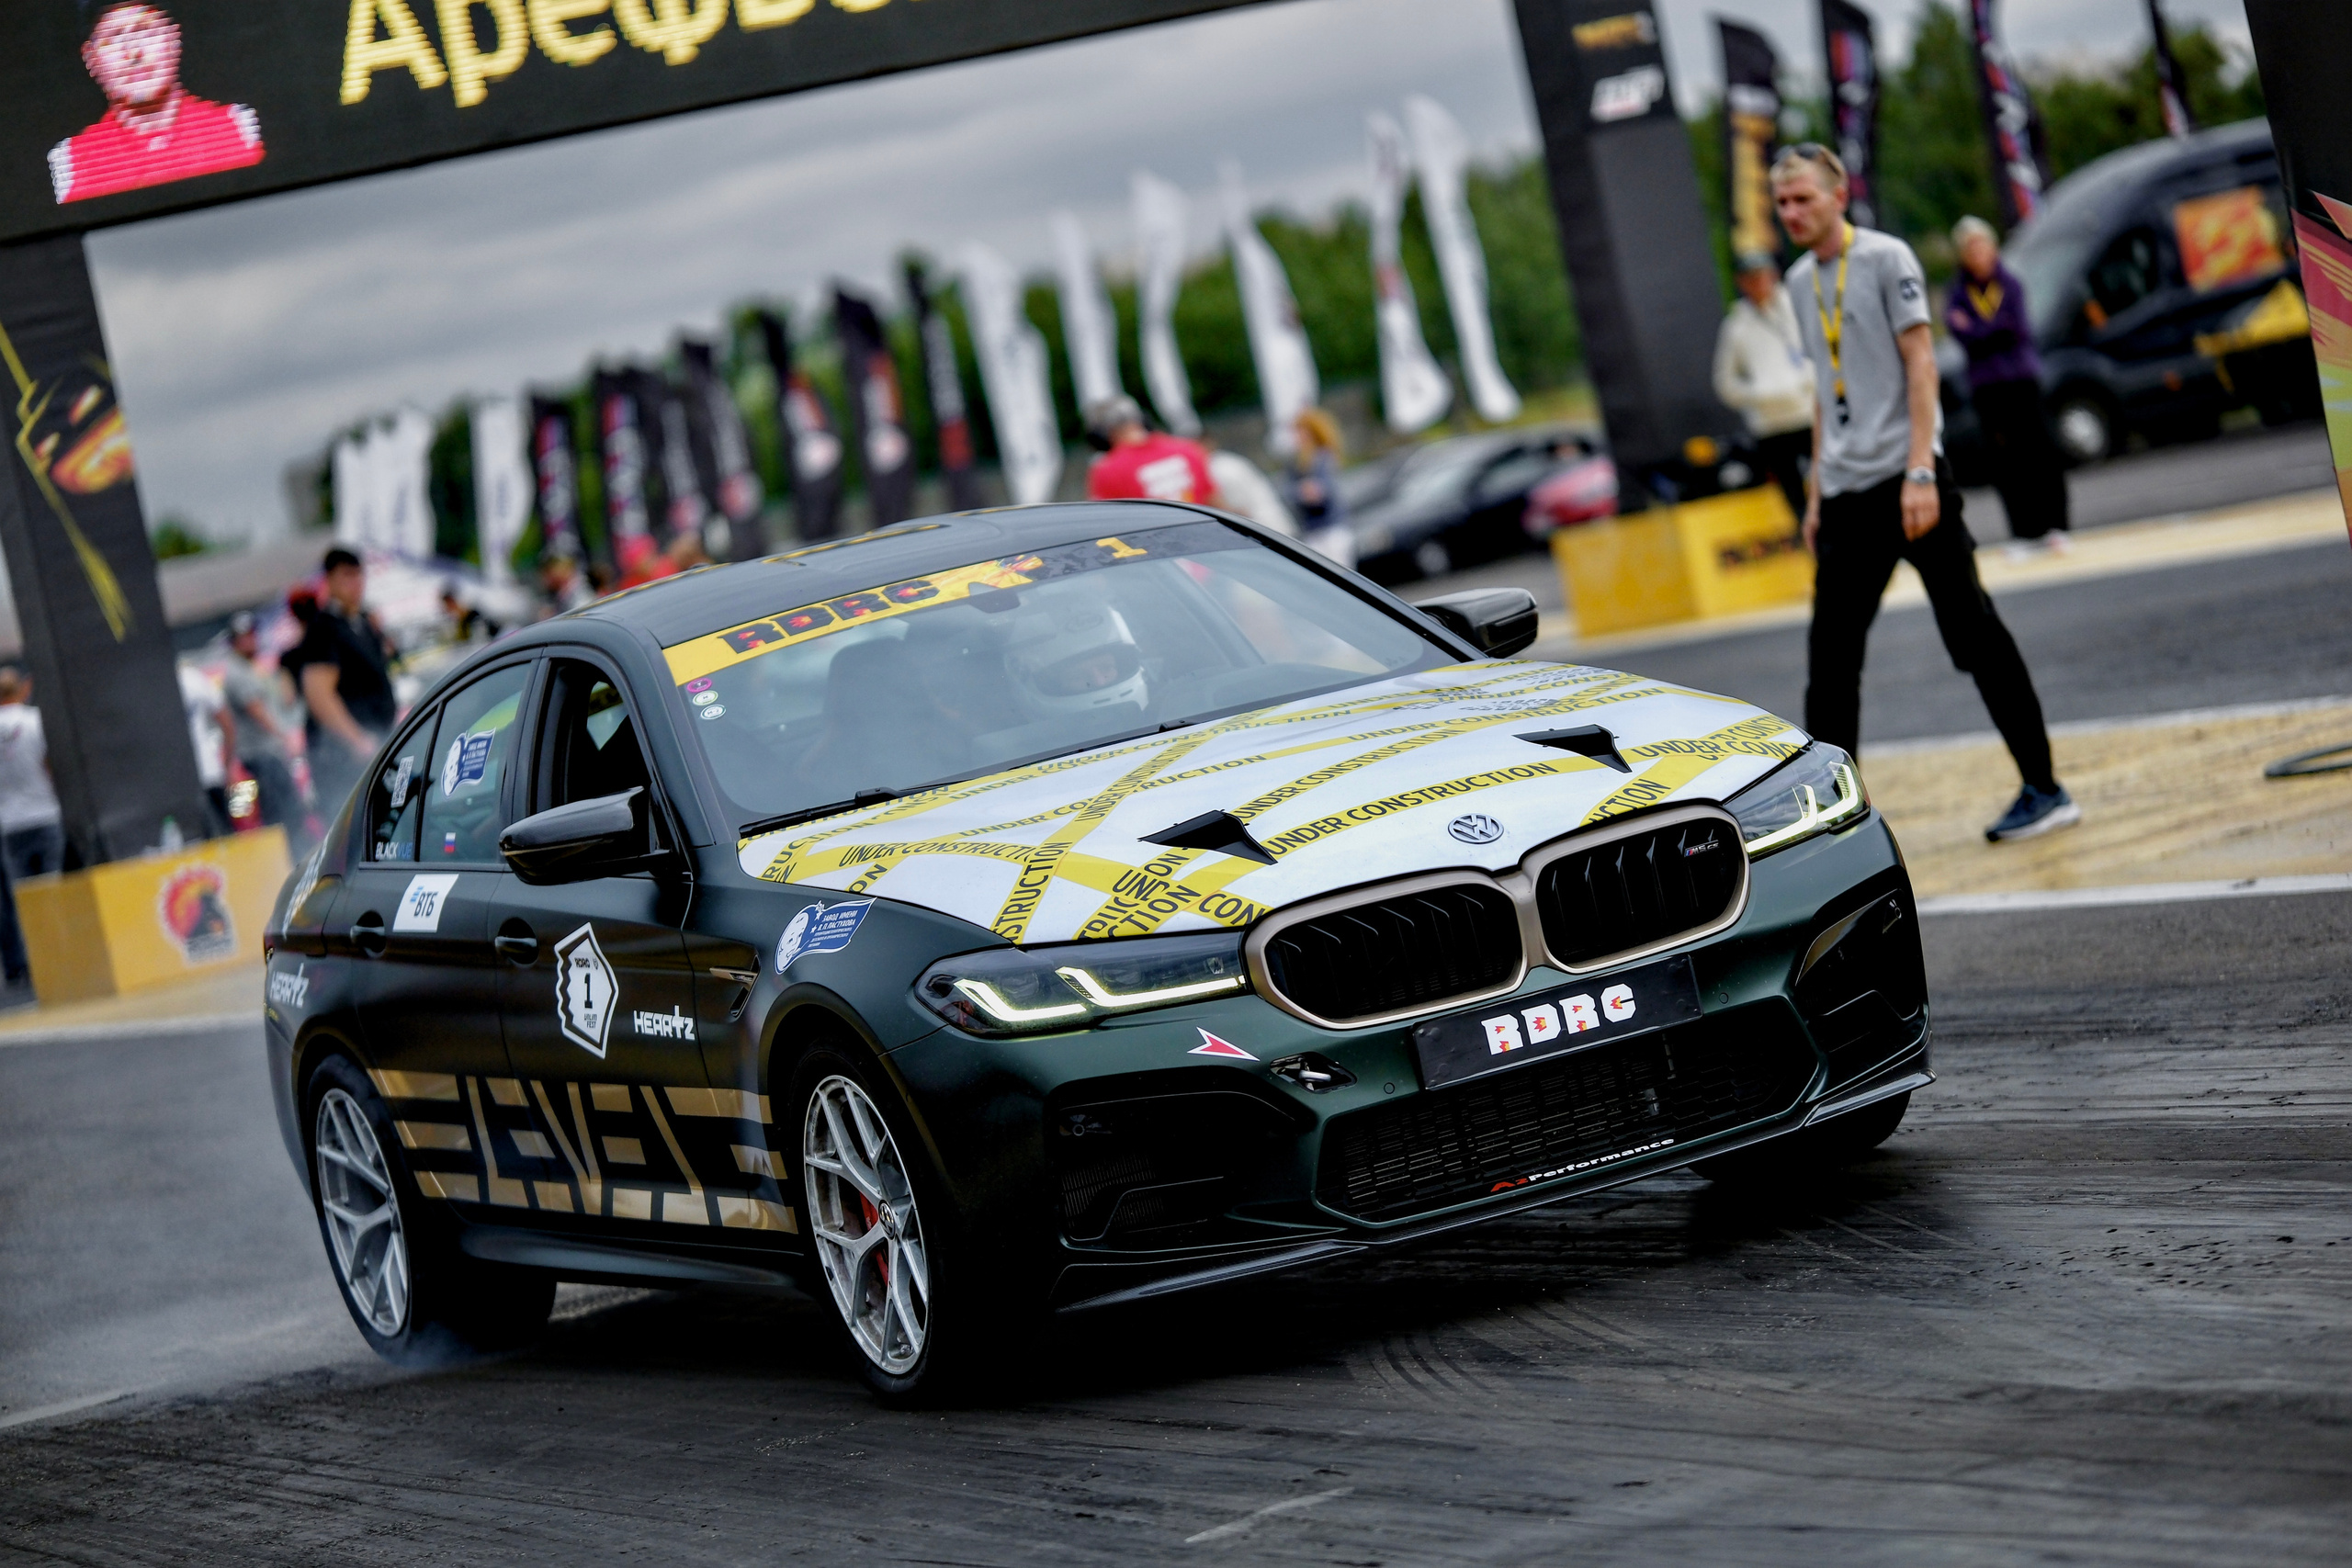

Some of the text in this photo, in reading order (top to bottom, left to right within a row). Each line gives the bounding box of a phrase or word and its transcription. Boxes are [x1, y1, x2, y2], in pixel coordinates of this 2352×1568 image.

[340, 0, 893, 107] Ареф
[1096, 536, 1148, 558] 1
[718, 580, 941, 654] RDRC
[1348, 721, 1437, 740] UNDER
[1444, 688, 1665, 726] CONSTRUCTION
[1633, 739, 1729, 758] UNDER
[950, 773, 1035, 800] UNDER
[1239, 728, 1461, 819] UNDER CONSTRUCTION
[1268, 762, 1559, 856] UNDER CONSTRUCTION
[959, 814, 1046, 837] UNDER
[375, 842, 413, 860] BLACKVUE
[839, 842, 1035, 867] UNDER CONSTRUCTI
[413, 891, 439, 918] ВТБ
[584, 973, 593, 1010] 1
[586, 1021, 597, 1029] FEST
[633, 1005, 695, 1041] HEARTZ
[1481, 983, 1636, 1055] RDRC
